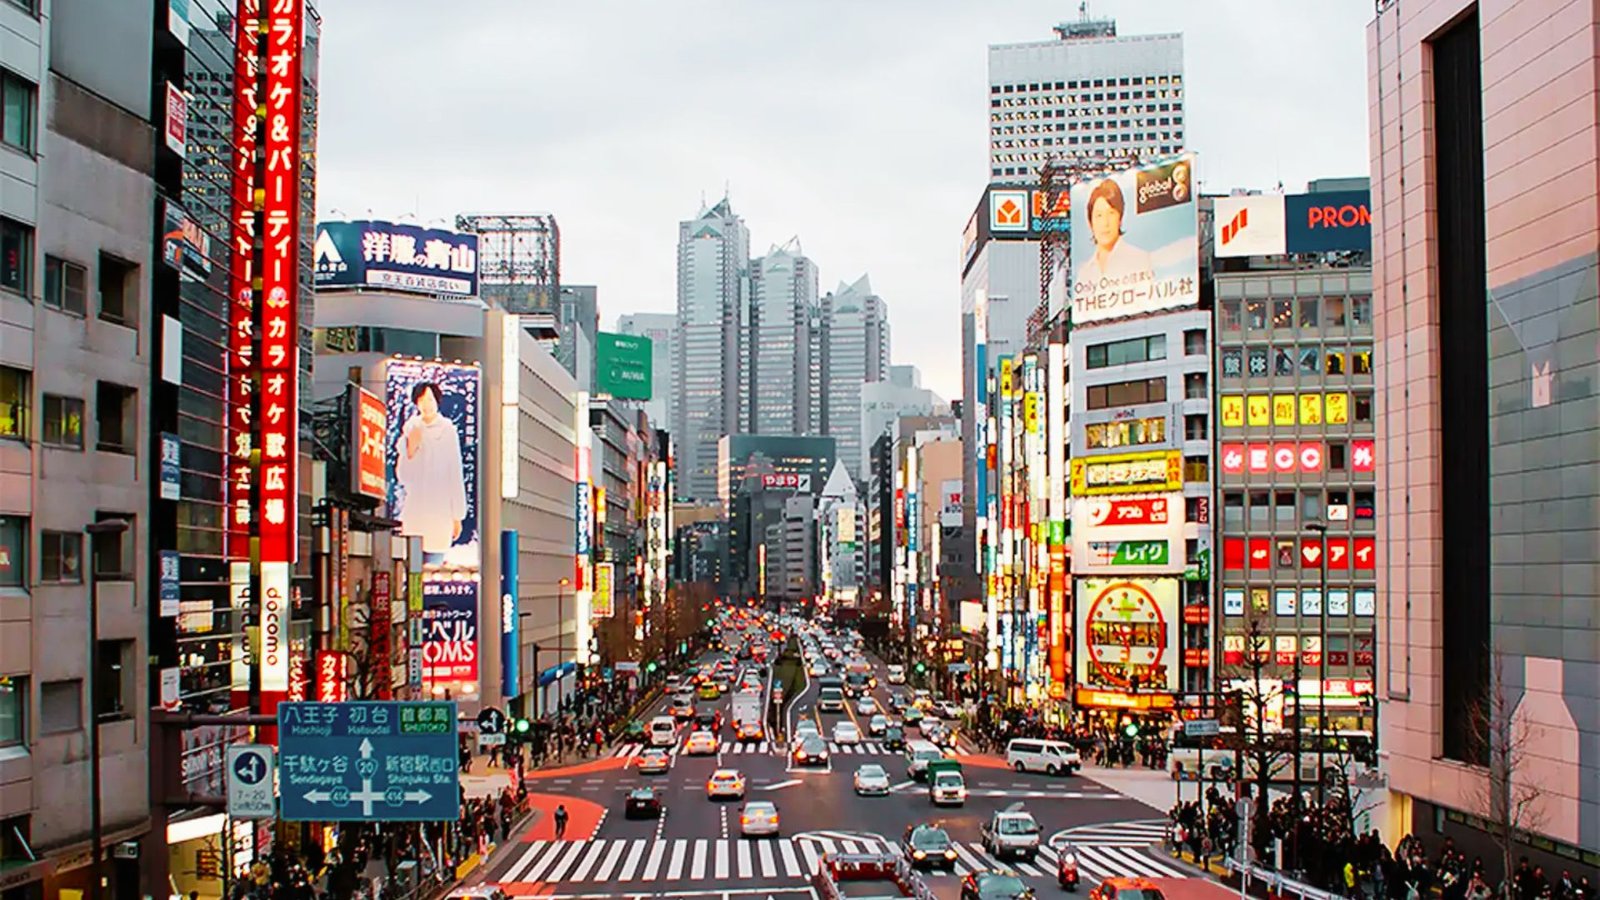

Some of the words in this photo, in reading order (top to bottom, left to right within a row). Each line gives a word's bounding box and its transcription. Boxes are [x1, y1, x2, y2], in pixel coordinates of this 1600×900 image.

[1139, 177, 1172, 204] global
[361, 231, 476, 273] 洋服の青山
[1075, 281, 1097, 295] Only
[1100, 277, 1120, 290] One
[265, 316, 286, 524] カラオケ歌広場
[1250, 449, 1320, 470] ECC
[1117, 506, 1144, 519] アコム
[1124, 543, 1163, 560] レイク
[266, 587, 281, 666] docomo
[284, 706, 339, 724] 八王子
[349, 706, 389, 724] 初台
[402, 707, 449, 723] 首都高
[291, 725, 333, 737] Hachioji
[347, 725, 391, 735] Hatsudai
[360, 762, 374, 773] 20
[385, 755, 454, 773] 新宿駅西口
[290, 774, 343, 785] Sendagaya
[388, 774, 430, 785] Shinjuku
